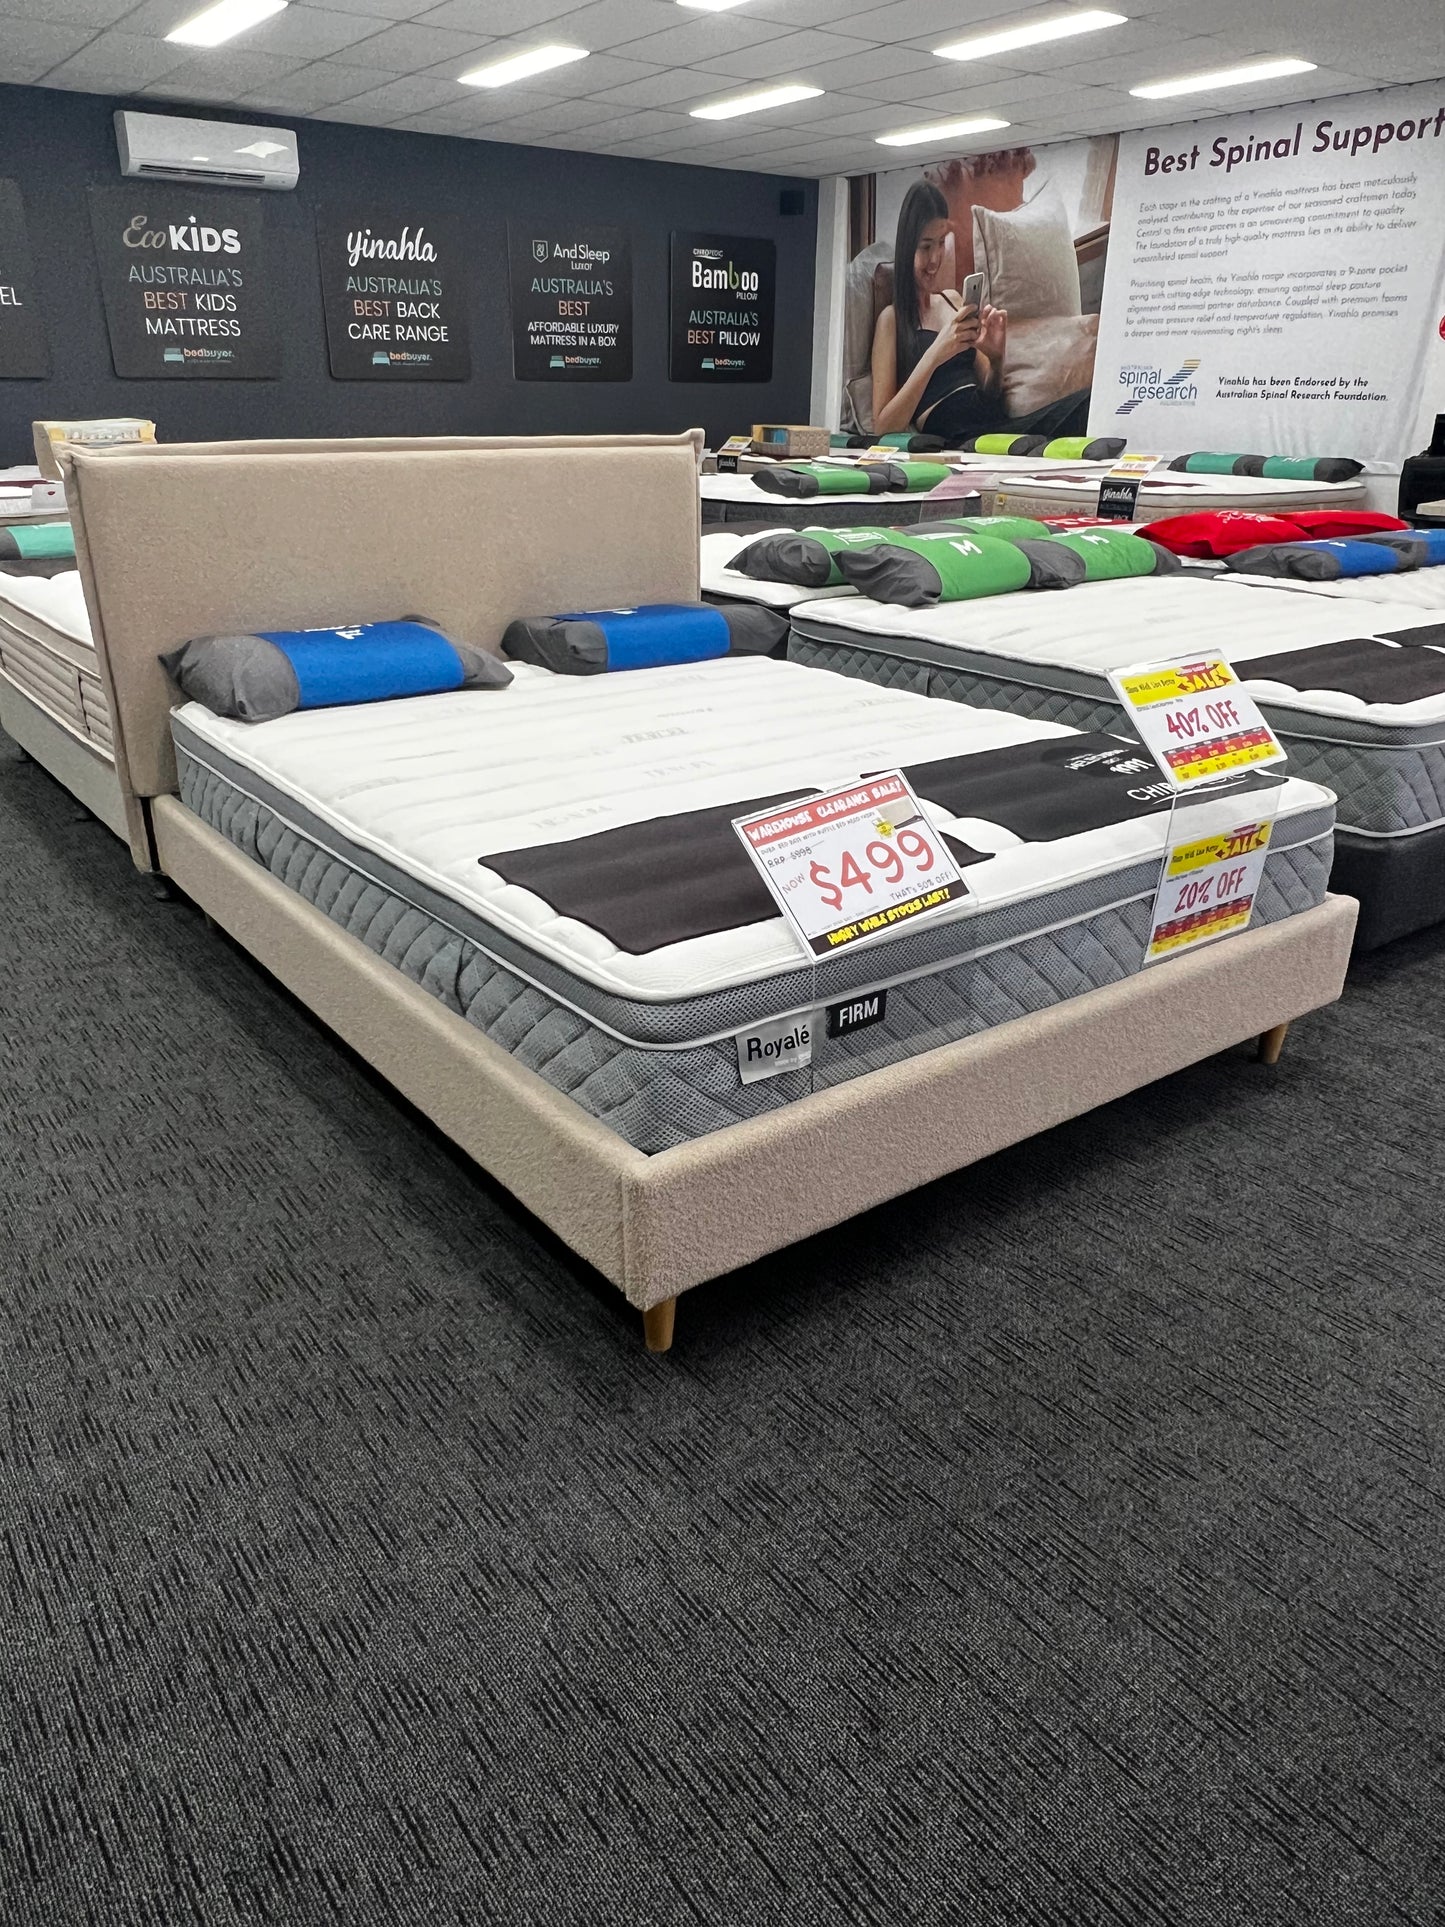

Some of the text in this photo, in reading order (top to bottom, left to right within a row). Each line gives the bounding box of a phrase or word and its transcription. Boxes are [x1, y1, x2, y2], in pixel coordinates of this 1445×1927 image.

[1144, 107, 1445, 176] Best Spinal Support
[129, 265, 243, 287] AUSTRALIA'S
[347, 276, 443, 296] AUSTRALIA'S
[692, 261, 759, 291] Bamboo
[531, 277, 614, 296] AUSTRALIA'S
[144, 291, 237, 312] BEST KIDS
[353, 299, 440, 319] BEST BACK
[558, 300, 590, 316] BEST
[145, 317, 241, 337] MATTRESS
[528, 321, 619, 334] AFFORDABLE LUXURY
[689, 310, 759, 326] AUSTRALIA'S
[348, 323, 449, 342] CARE RANGE
[530, 335, 616, 347] MATTRESS IN A BOX
[687, 330, 760, 346] BEST PILLOW
[1119, 368, 1162, 387] spinal
[1252, 376, 1267, 387] has
[1270, 376, 1291, 387] been
[1294, 376, 1336, 387] Endorsed
[1339, 377, 1350, 389] by
[1354, 377, 1369, 387] the
[1132, 383, 1198, 400] research
[1216, 390, 1258, 399] Australian
[1260, 390, 1288, 401] Spinal
[1290, 390, 1331, 400] Research
[1181, 669, 1226, 692] SALE
[1166, 711, 1210, 740] 40%
[1206, 700, 1241, 729] OFF
[747, 780, 902, 842] WAREHOUSE CLEARANCE SALE!
[782, 829, 934, 911] NOW $499
[917, 878, 935, 893] 50%
[935, 870, 955, 885] OFF!
[1174, 876, 1213, 914] 20%
[1216, 865, 1247, 895] OFF
[827, 924, 859, 946] HURRY
[858, 914, 888, 933] WHILE
[885, 898, 922, 922] STOCKS
[921, 887, 951, 908] LAST!
[839, 997, 879, 1028] FIRM
[746, 1024, 810, 1062] Royalé
